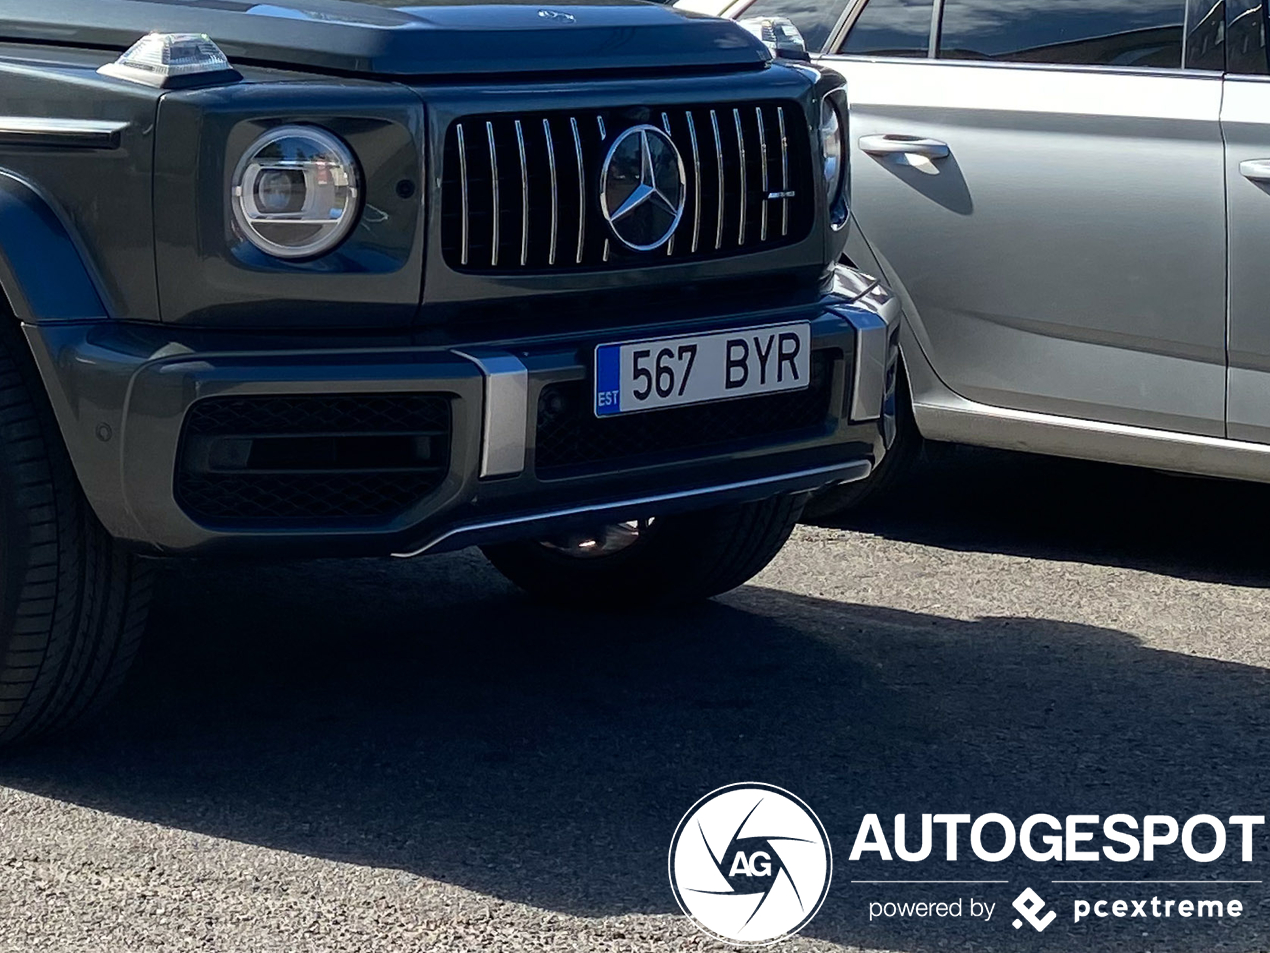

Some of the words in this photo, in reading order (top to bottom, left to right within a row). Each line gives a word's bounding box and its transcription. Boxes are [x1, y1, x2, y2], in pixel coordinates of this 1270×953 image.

[632, 344, 698, 402] 567
[725, 332, 801, 390] BYR
[598, 390, 619, 407] EST
